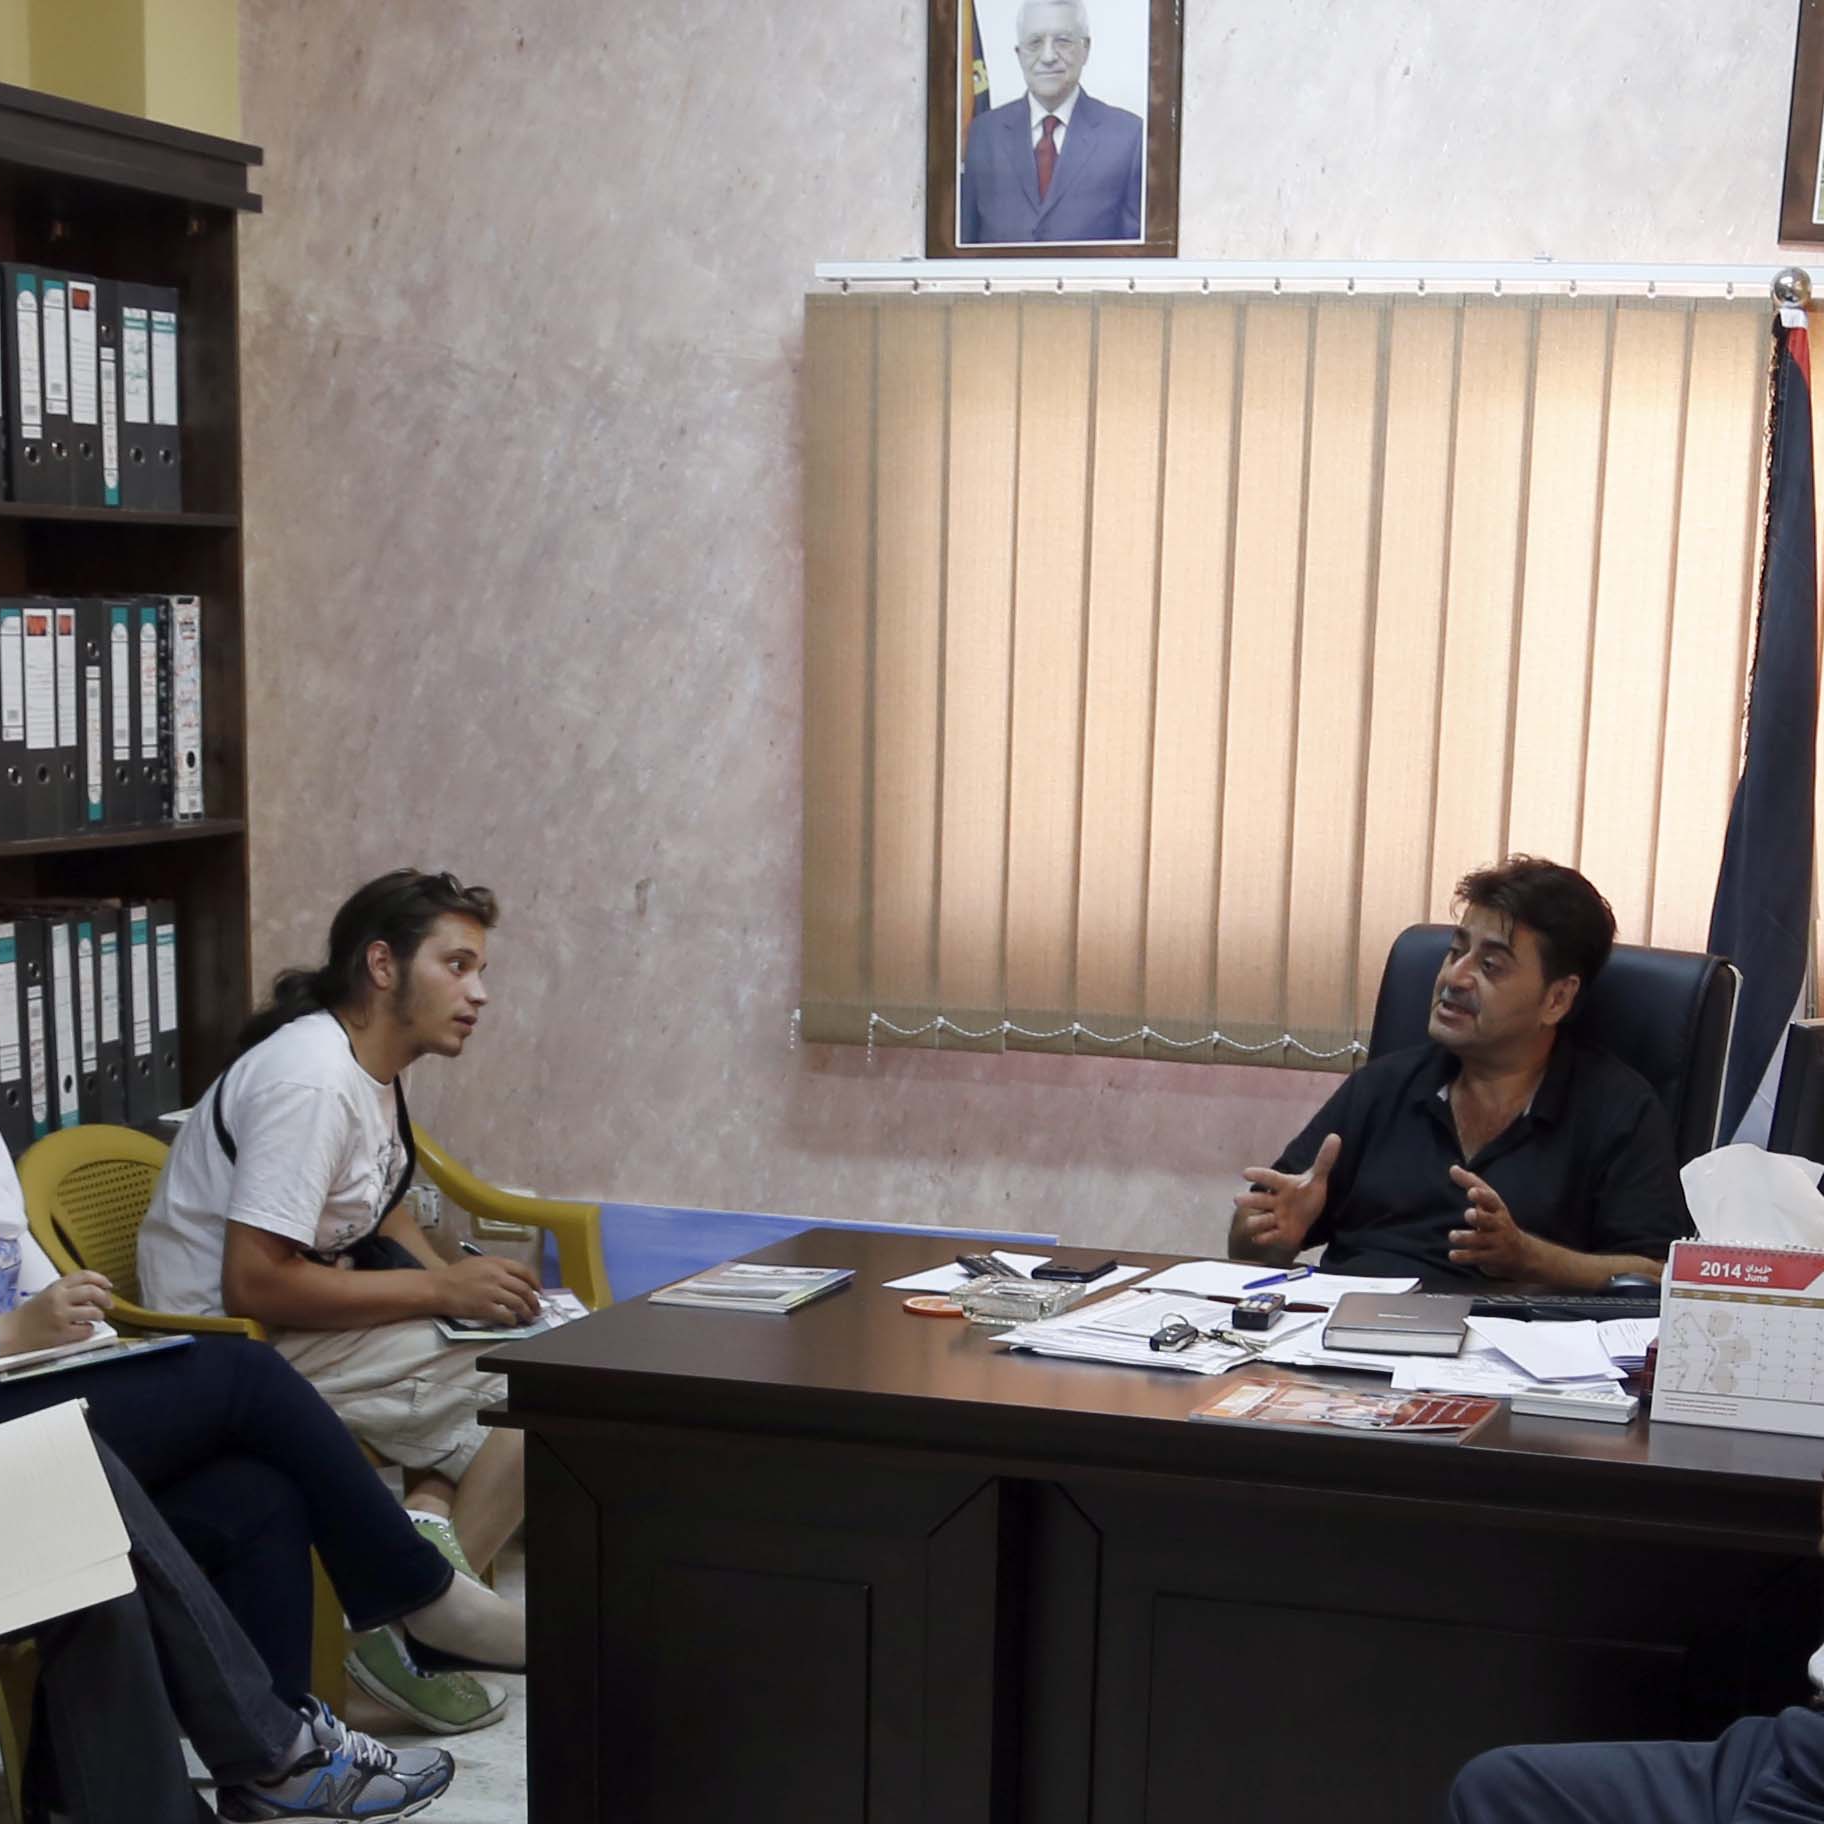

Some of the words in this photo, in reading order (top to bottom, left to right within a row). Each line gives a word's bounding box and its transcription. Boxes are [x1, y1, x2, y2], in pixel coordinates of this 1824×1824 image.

[1700, 1261, 1742, 1278] 2014
[1745, 1264, 1773, 1275] حزيران
[1744, 1274, 1769, 1283] June
